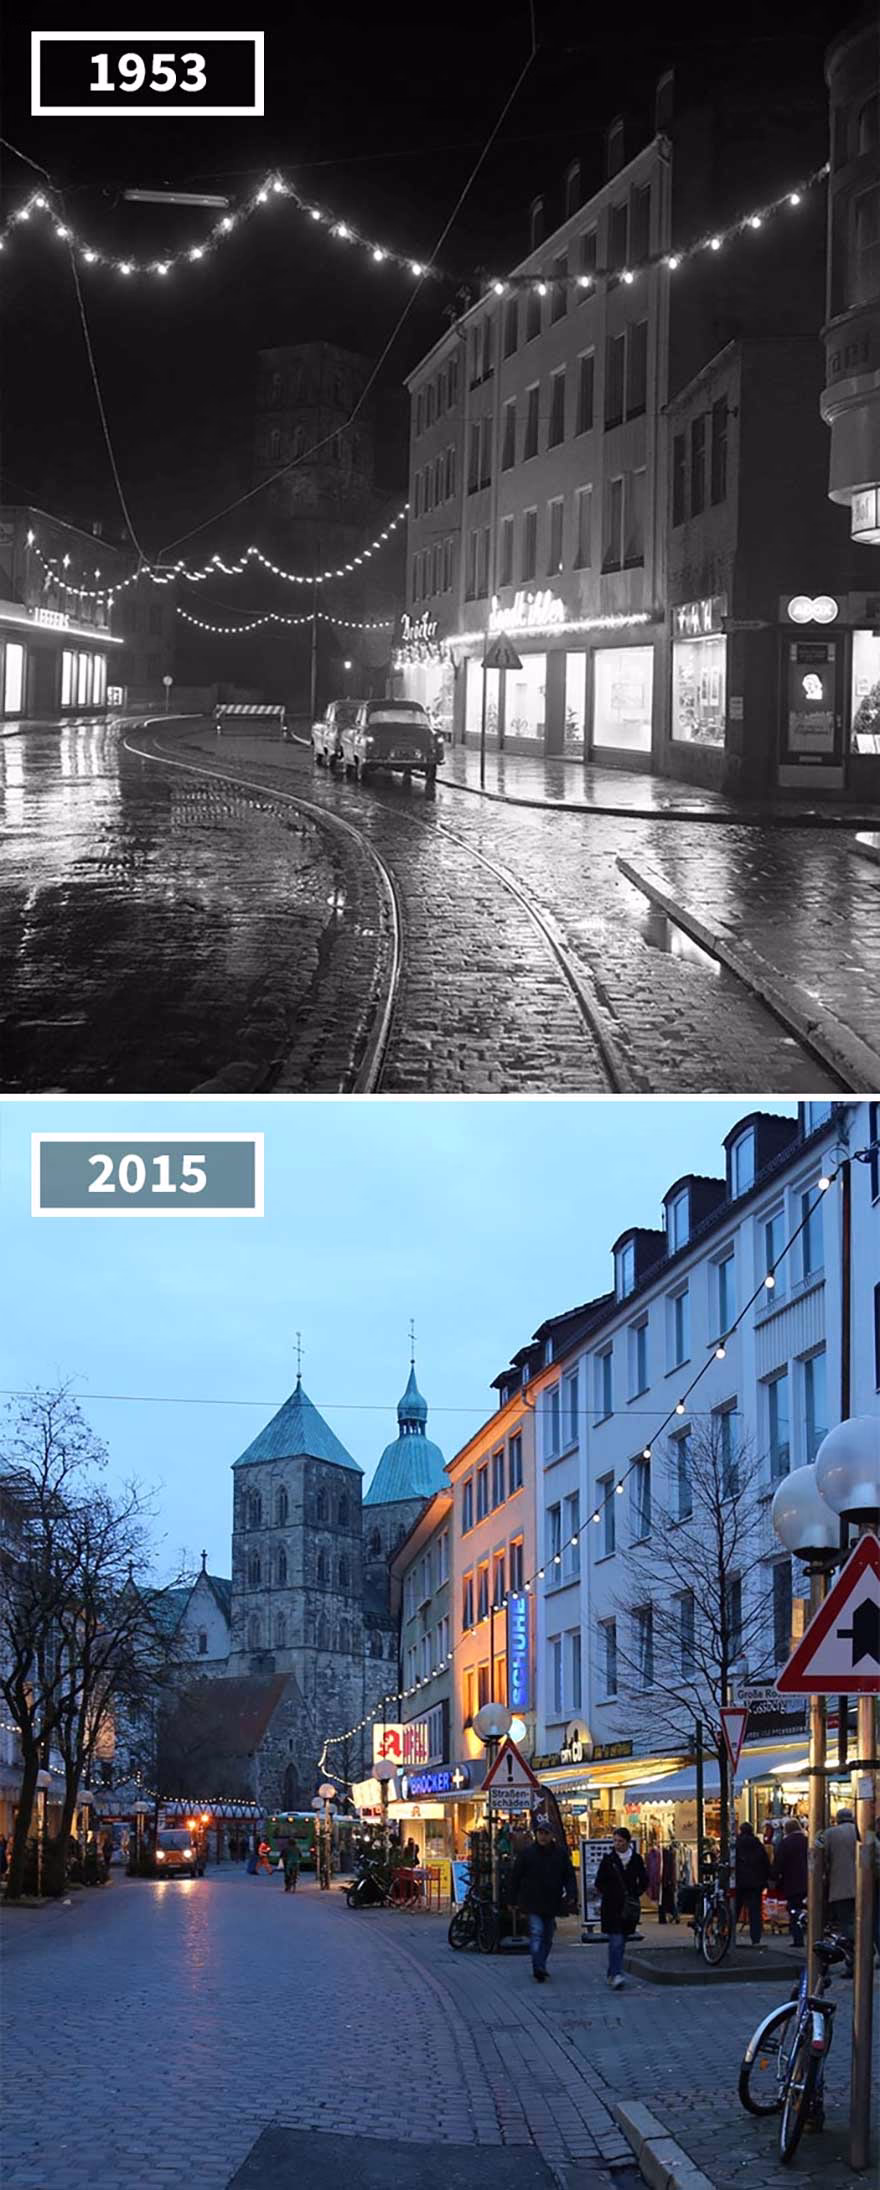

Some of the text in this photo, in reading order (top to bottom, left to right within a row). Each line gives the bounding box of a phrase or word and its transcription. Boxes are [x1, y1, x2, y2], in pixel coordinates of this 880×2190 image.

[512, 1597, 526, 1705] SCHUHE
[737, 1689, 763, 1699] Große
[410, 1772, 451, 1794] BRÖCKER
[492, 1789, 530, 1799] Straßen-
[492, 1798, 530, 1807] schäden
